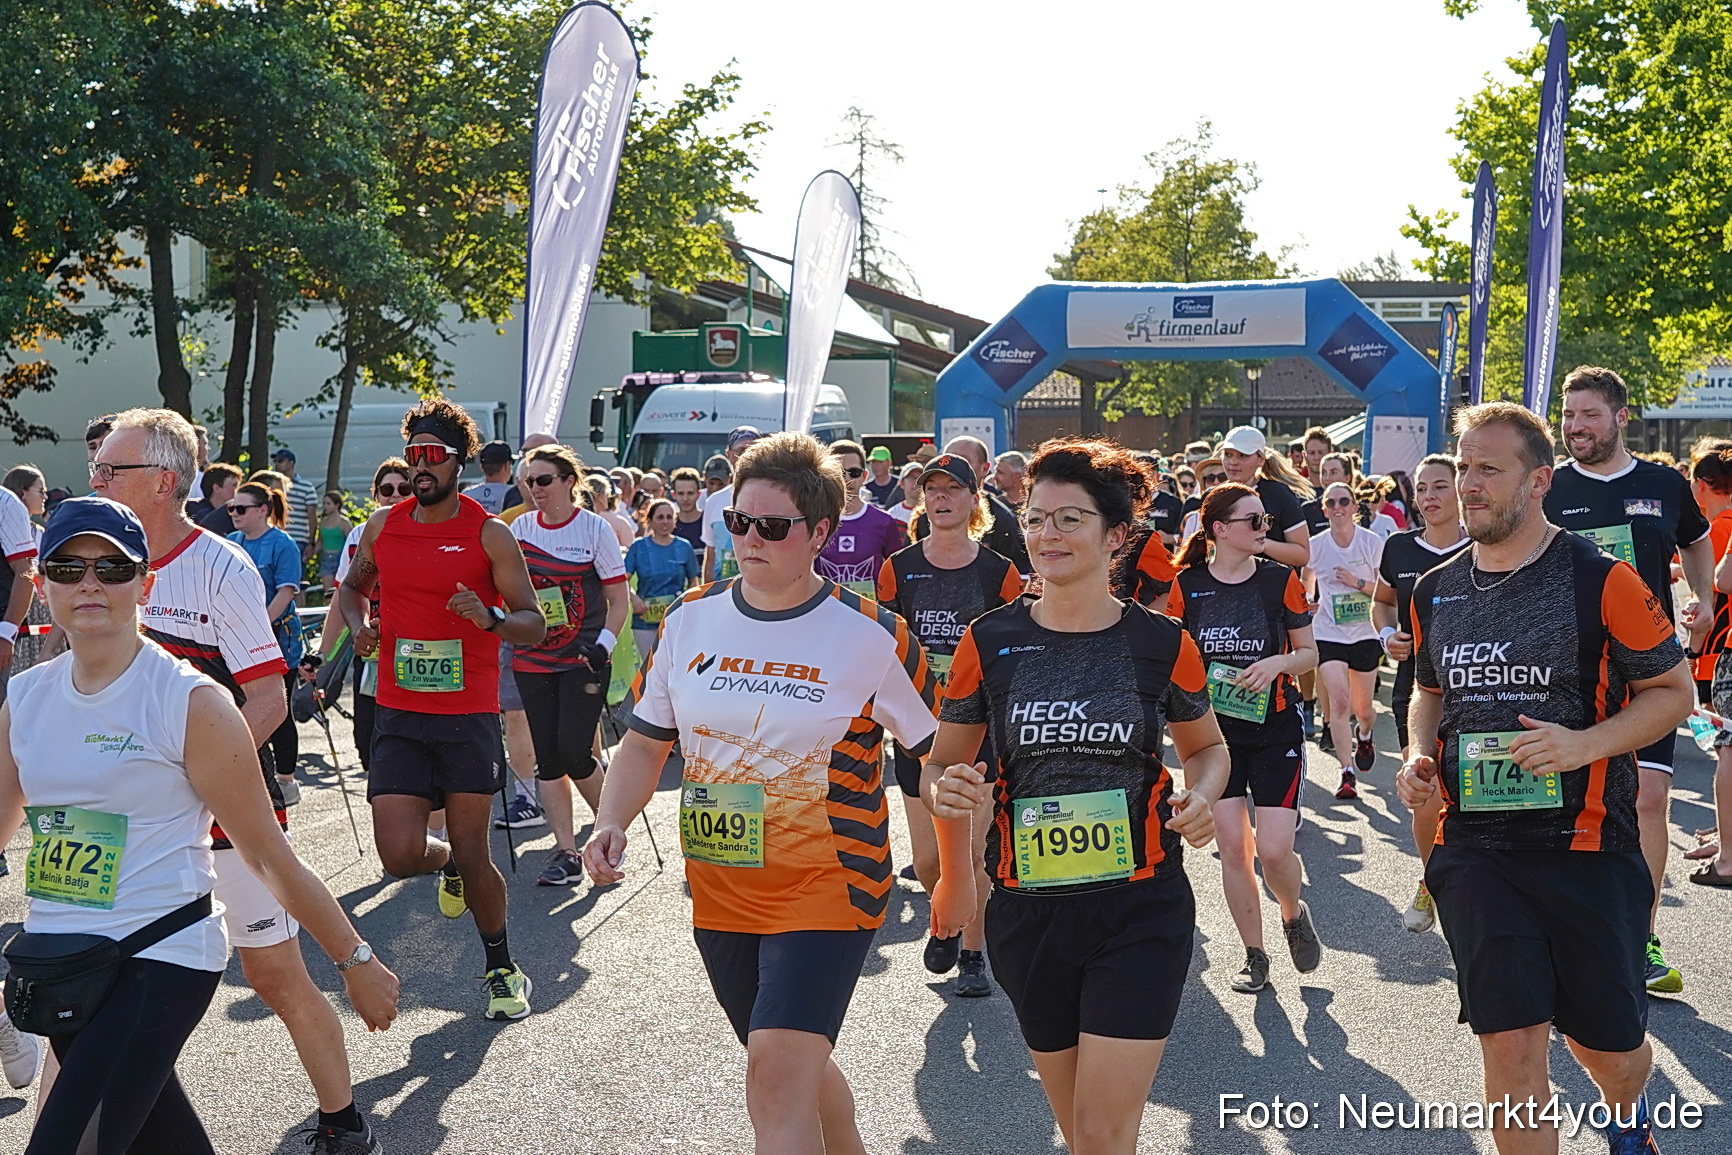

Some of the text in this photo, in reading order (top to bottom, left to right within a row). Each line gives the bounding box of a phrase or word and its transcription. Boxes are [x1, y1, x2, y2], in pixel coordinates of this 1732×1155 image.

[565, 42, 610, 184] Fischer
[587, 62, 619, 177] AUTOMOBILE
[812, 197, 844, 292] Fischer
[1158, 318, 1247, 336] firmenlauf
[989, 347, 1037, 359] Fischer
[1347, 344, 1360, 352] das
[1562, 507, 1584, 516] CRAFT
[144, 606, 199, 622] NEUMARKT
[914, 610, 960, 623] HECK
[1340, 601, 1367, 614] 1469
[920, 623, 968, 637] DESIG
[1198, 626, 1242, 640] HECK
[1204, 639, 1265, 653] DESIGN
[1441, 642, 1512, 667] HECK
[397, 662, 405, 680] RUN
[405, 657, 452, 676] 1676
[452, 660, 460, 684] 2022
[718, 656, 829, 685] KLEBL
[1448, 665, 1552, 689] DESIGN
[709, 676, 826, 704] DYNAMICS
[1215, 681, 1259, 706] 1742
[1496, 691, 1550, 702] Werbung!
[1010, 700, 1092, 723] HECK
[1228, 700, 1255, 712] Rebecca
[1256, 693, 1267, 716] 2022
[84, 733, 124, 743] BioMarkt
[1019, 722, 1134, 746] DESIGN
[1072, 745, 1126, 757] Werbung!
[1464, 769, 1473, 796] RUN
[1482, 786, 1535, 796] Heck Mario
[689, 810, 746, 840] 1049
[1038, 810, 1074, 822] Firmenlauf
[682, 812, 694, 849] WALK
[749, 817, 758, 856] 2022
[1031, 822, 1111, 857] 1990
[40, 837, 103, 875] 1472
[690, 837, 749, 852] Mederer Sandra
[1020, 833, 1031, 876] WALK
[1113, 825, 1128, 866] 2022
[29, 839, 43, 884] WALK
[99, 851, 117, 895] 2022
[39, 870, 89, 889] Melnik Batja
